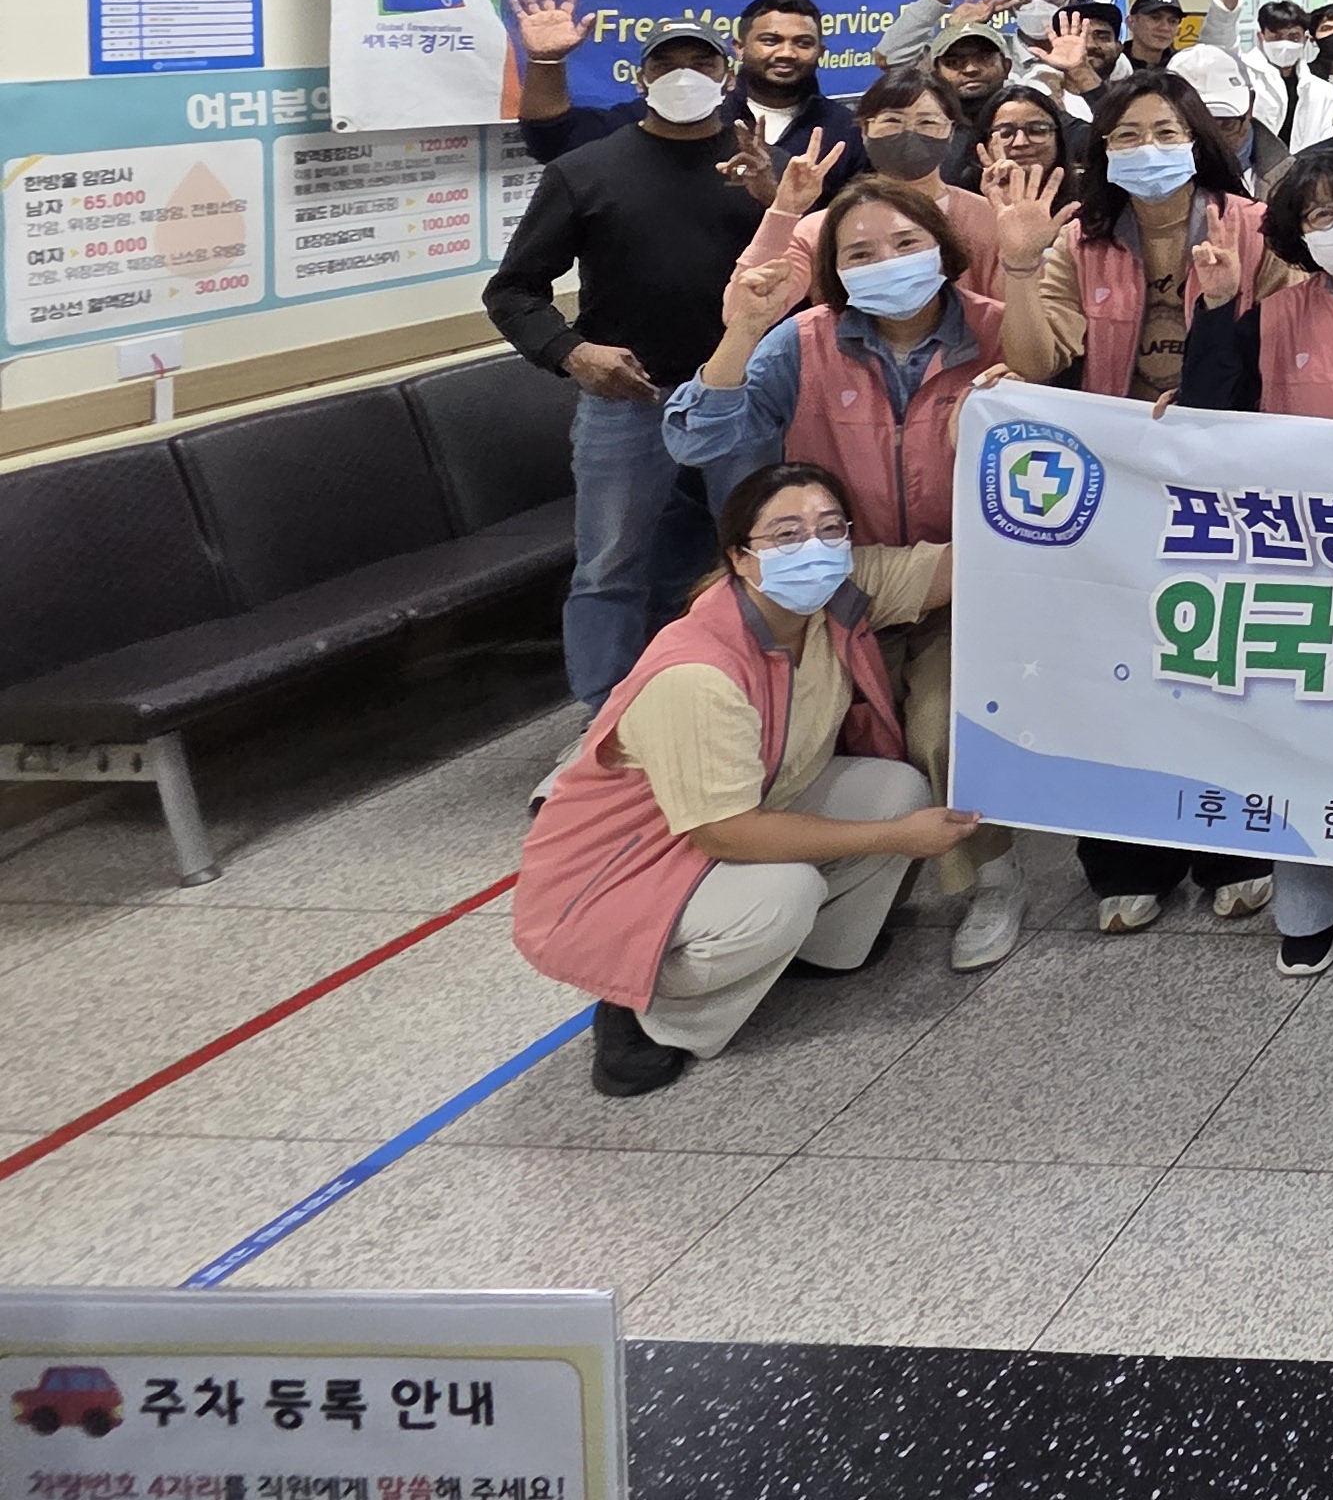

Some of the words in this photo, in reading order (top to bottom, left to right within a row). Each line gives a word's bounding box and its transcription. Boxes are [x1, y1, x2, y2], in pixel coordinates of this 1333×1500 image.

[594, 8, 668, 42] Fre
[820, 6, 894, 35] ervice
[418, 33, 476, 54] 경기도
[26, 199, 63, 217] 남자
[27, 247, 65, 265] 여자
[985, 453, 999, 514] GYEONGGI
[1083, 462, 1101, 507] CENTER
[139, 1379, 245, 1426] 주차
[263, 1378, 366, 1431] 등록
[390, 1377, 496, 1430] 안내
